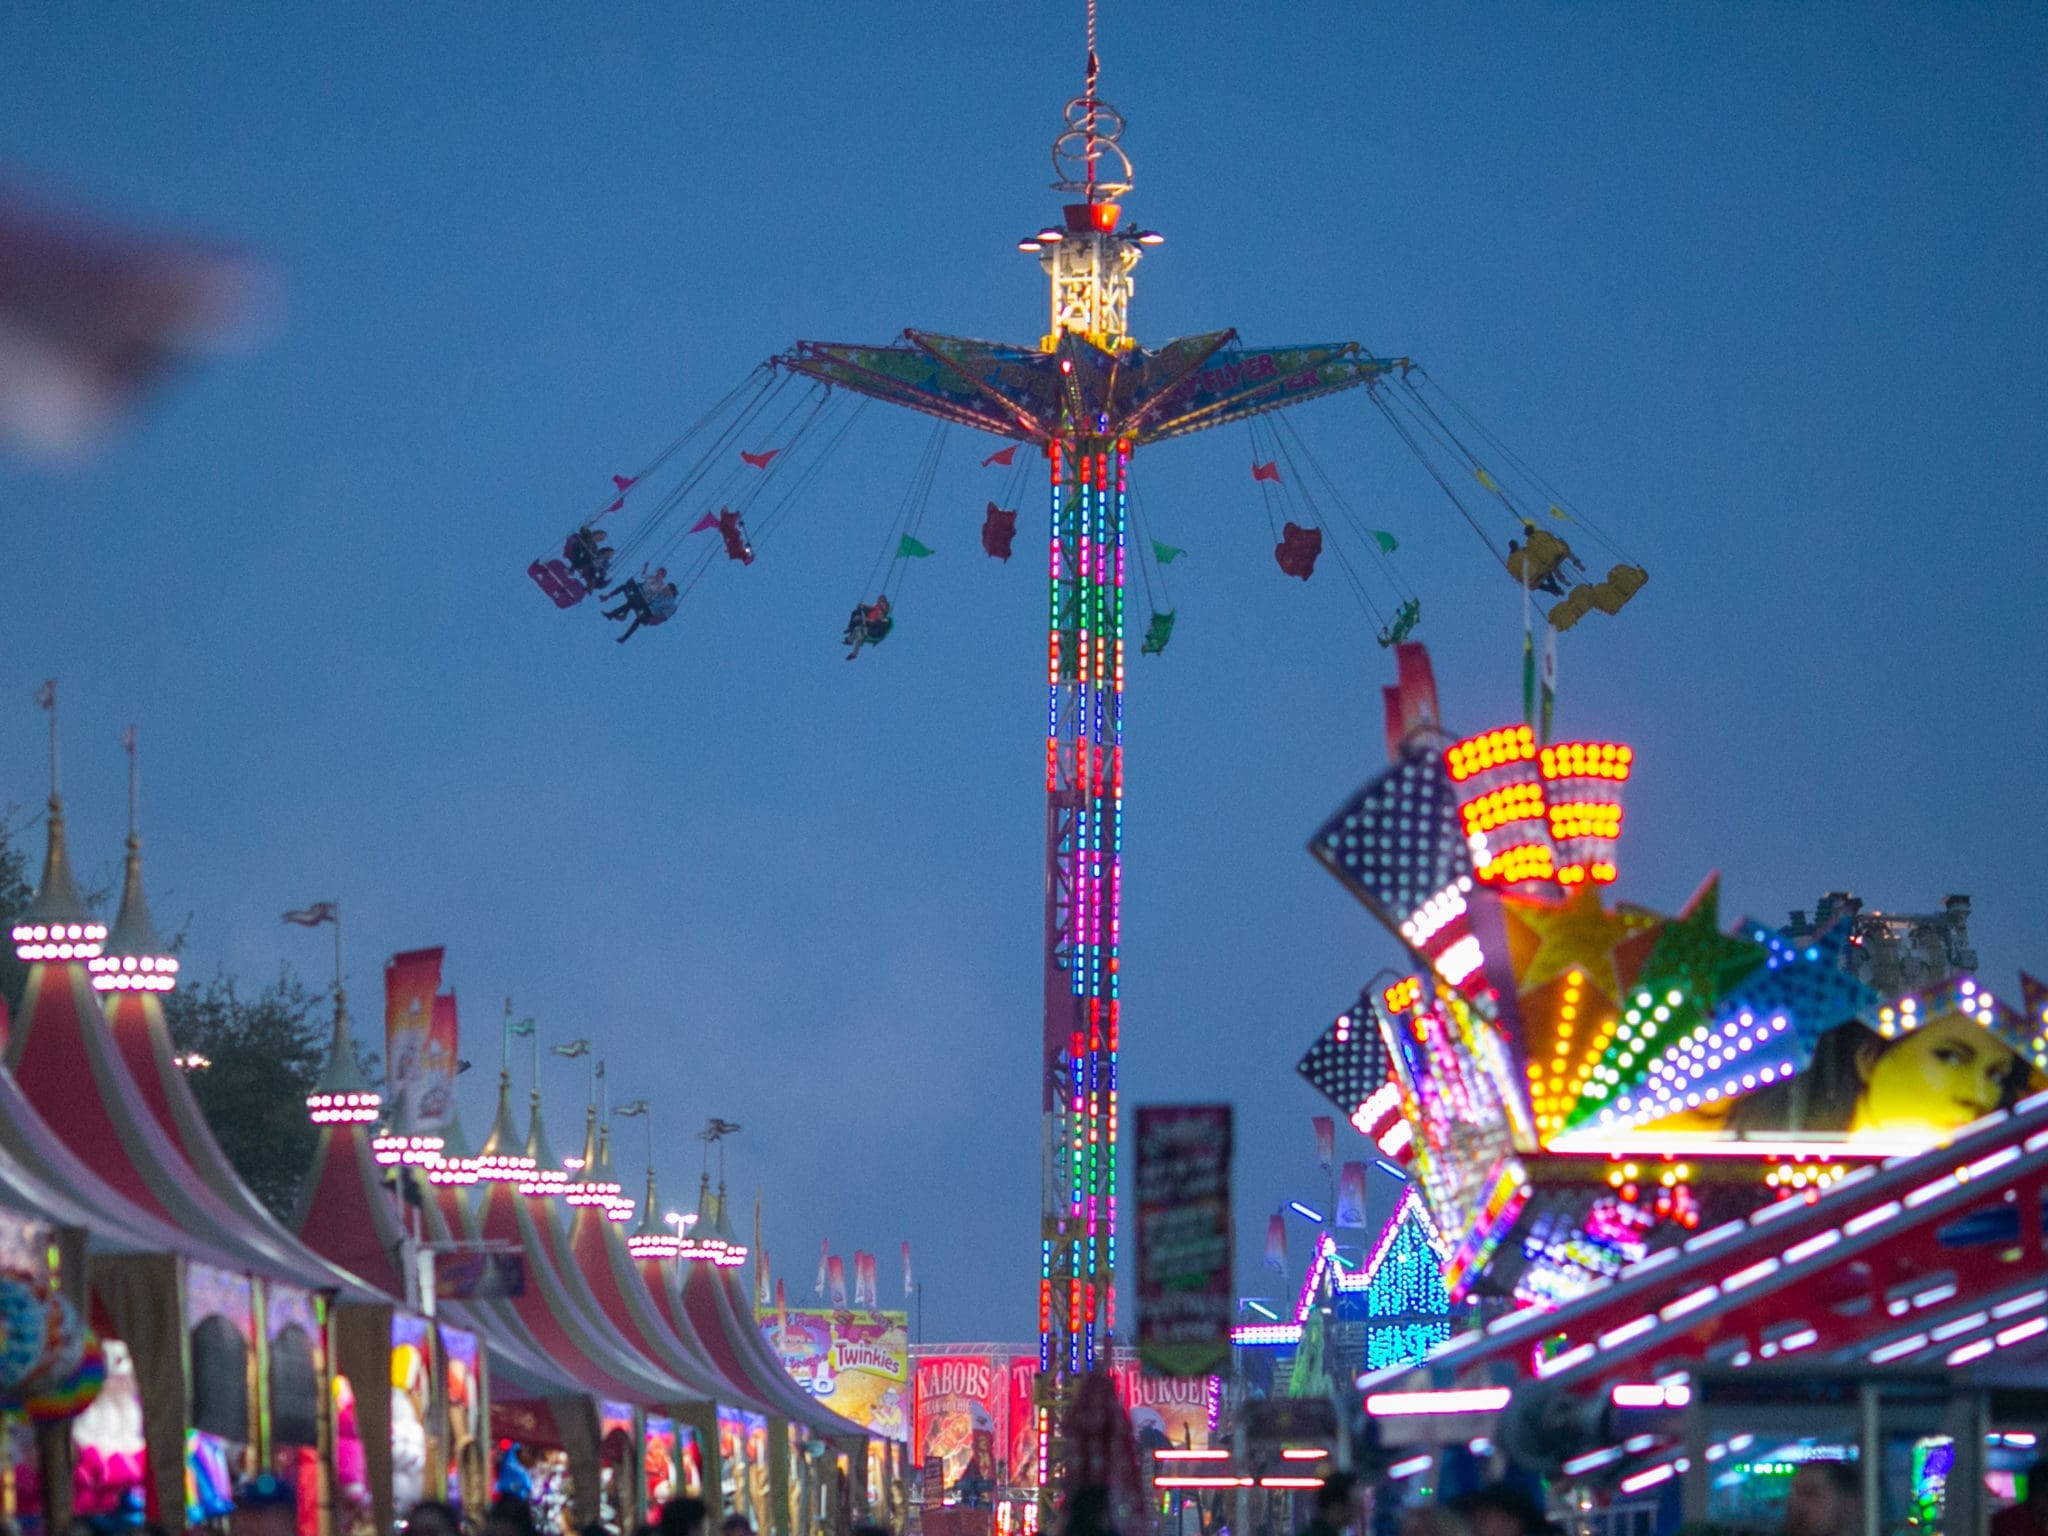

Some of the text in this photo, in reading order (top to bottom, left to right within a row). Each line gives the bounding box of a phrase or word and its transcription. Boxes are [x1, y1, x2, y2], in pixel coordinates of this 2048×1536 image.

[1201, 354, 1279, 392] FLYER
[835, 1341, 900, 1374] Twinkies
[917, 1362, 990, 1400] KABOBS
